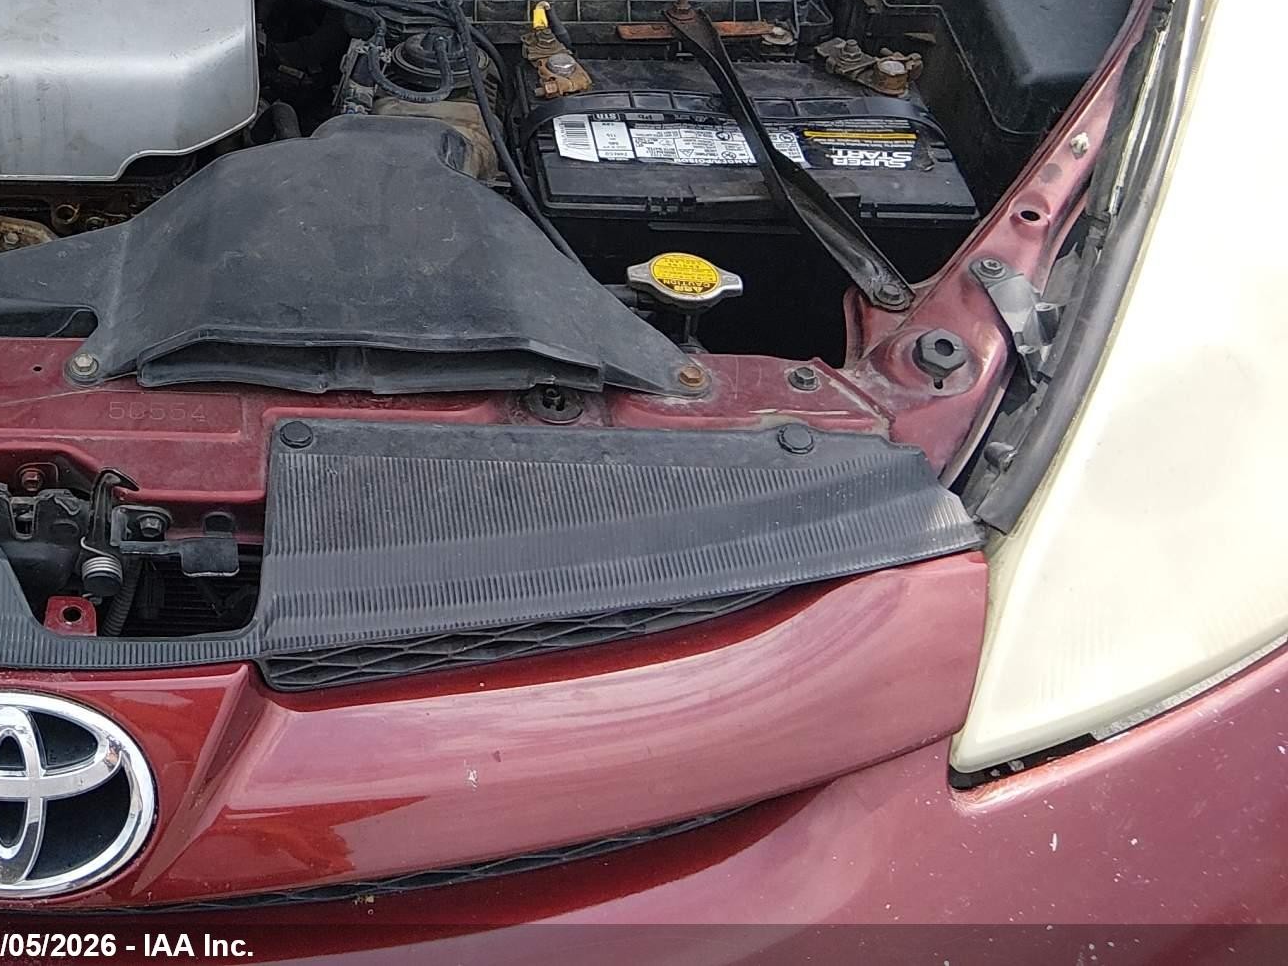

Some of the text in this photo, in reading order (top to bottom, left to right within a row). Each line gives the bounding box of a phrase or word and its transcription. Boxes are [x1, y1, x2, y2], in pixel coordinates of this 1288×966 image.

[832, 149, 913, 162] START
[832, 157, 907, 168] SUPER
[663, 279, 710, 288] CAUTION
